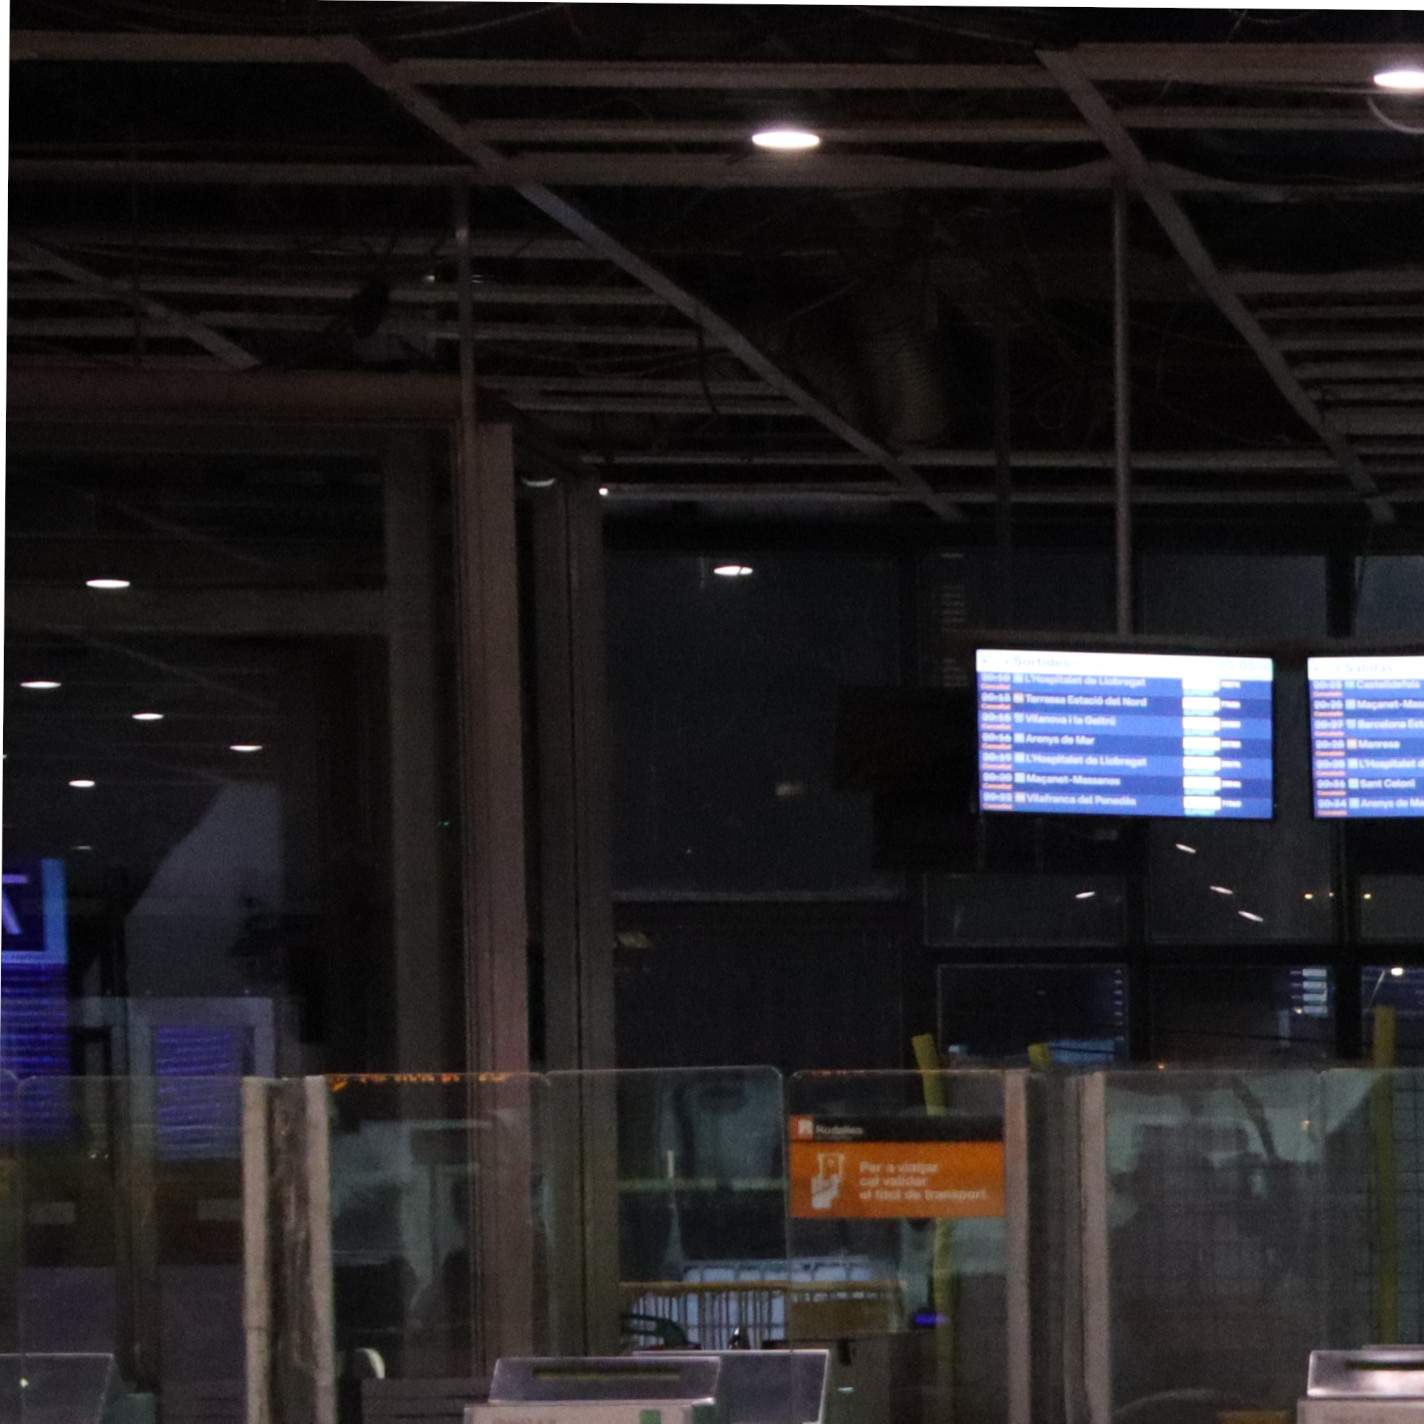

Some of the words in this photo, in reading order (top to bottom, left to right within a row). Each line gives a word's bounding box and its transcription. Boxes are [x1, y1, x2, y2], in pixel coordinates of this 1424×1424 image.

[1084, 676, 1097, 685] de
[1099, 676, 1146, 688] Llobregat
[1026, 694, 1066, 704] Terrassa
[1067, 694, 1104, 705] Estació
[1105, 696, 1121, 705] del
[1122, 697, 1147, 707] Nord
[1025, 713, 1067, 724] Vilanova
[1357, 719, 1407, 729] Barcelona
[1061, 735, 1074, 744] de
[1075, 735, 1096, 745] Mar
[1358, 740, 1400, 749] Manresa
[1085, 755, 1098, 764] de
[1100, 756, 1147, 768] Llobregat
[1026, 774, 1121, 786] Maçanet-Massanes
[1360, 779, 1382, 788] Sant
[1026, 794, 1076, 805] Vilafranca
[1077, 795, 1093, 805] del
[1395, 799, 1409, 808] de
[860, 1161, 881, 1173] Per
[887, 1164, 896, 1174] a
[859, 1176, 879, 1187] cal
[883, 1176, 929, 1187] validar
[859, 1189, 872, 1200] el
[904, 1190, 921, 1200] de
[925, 1190, 987, 1202] transport
